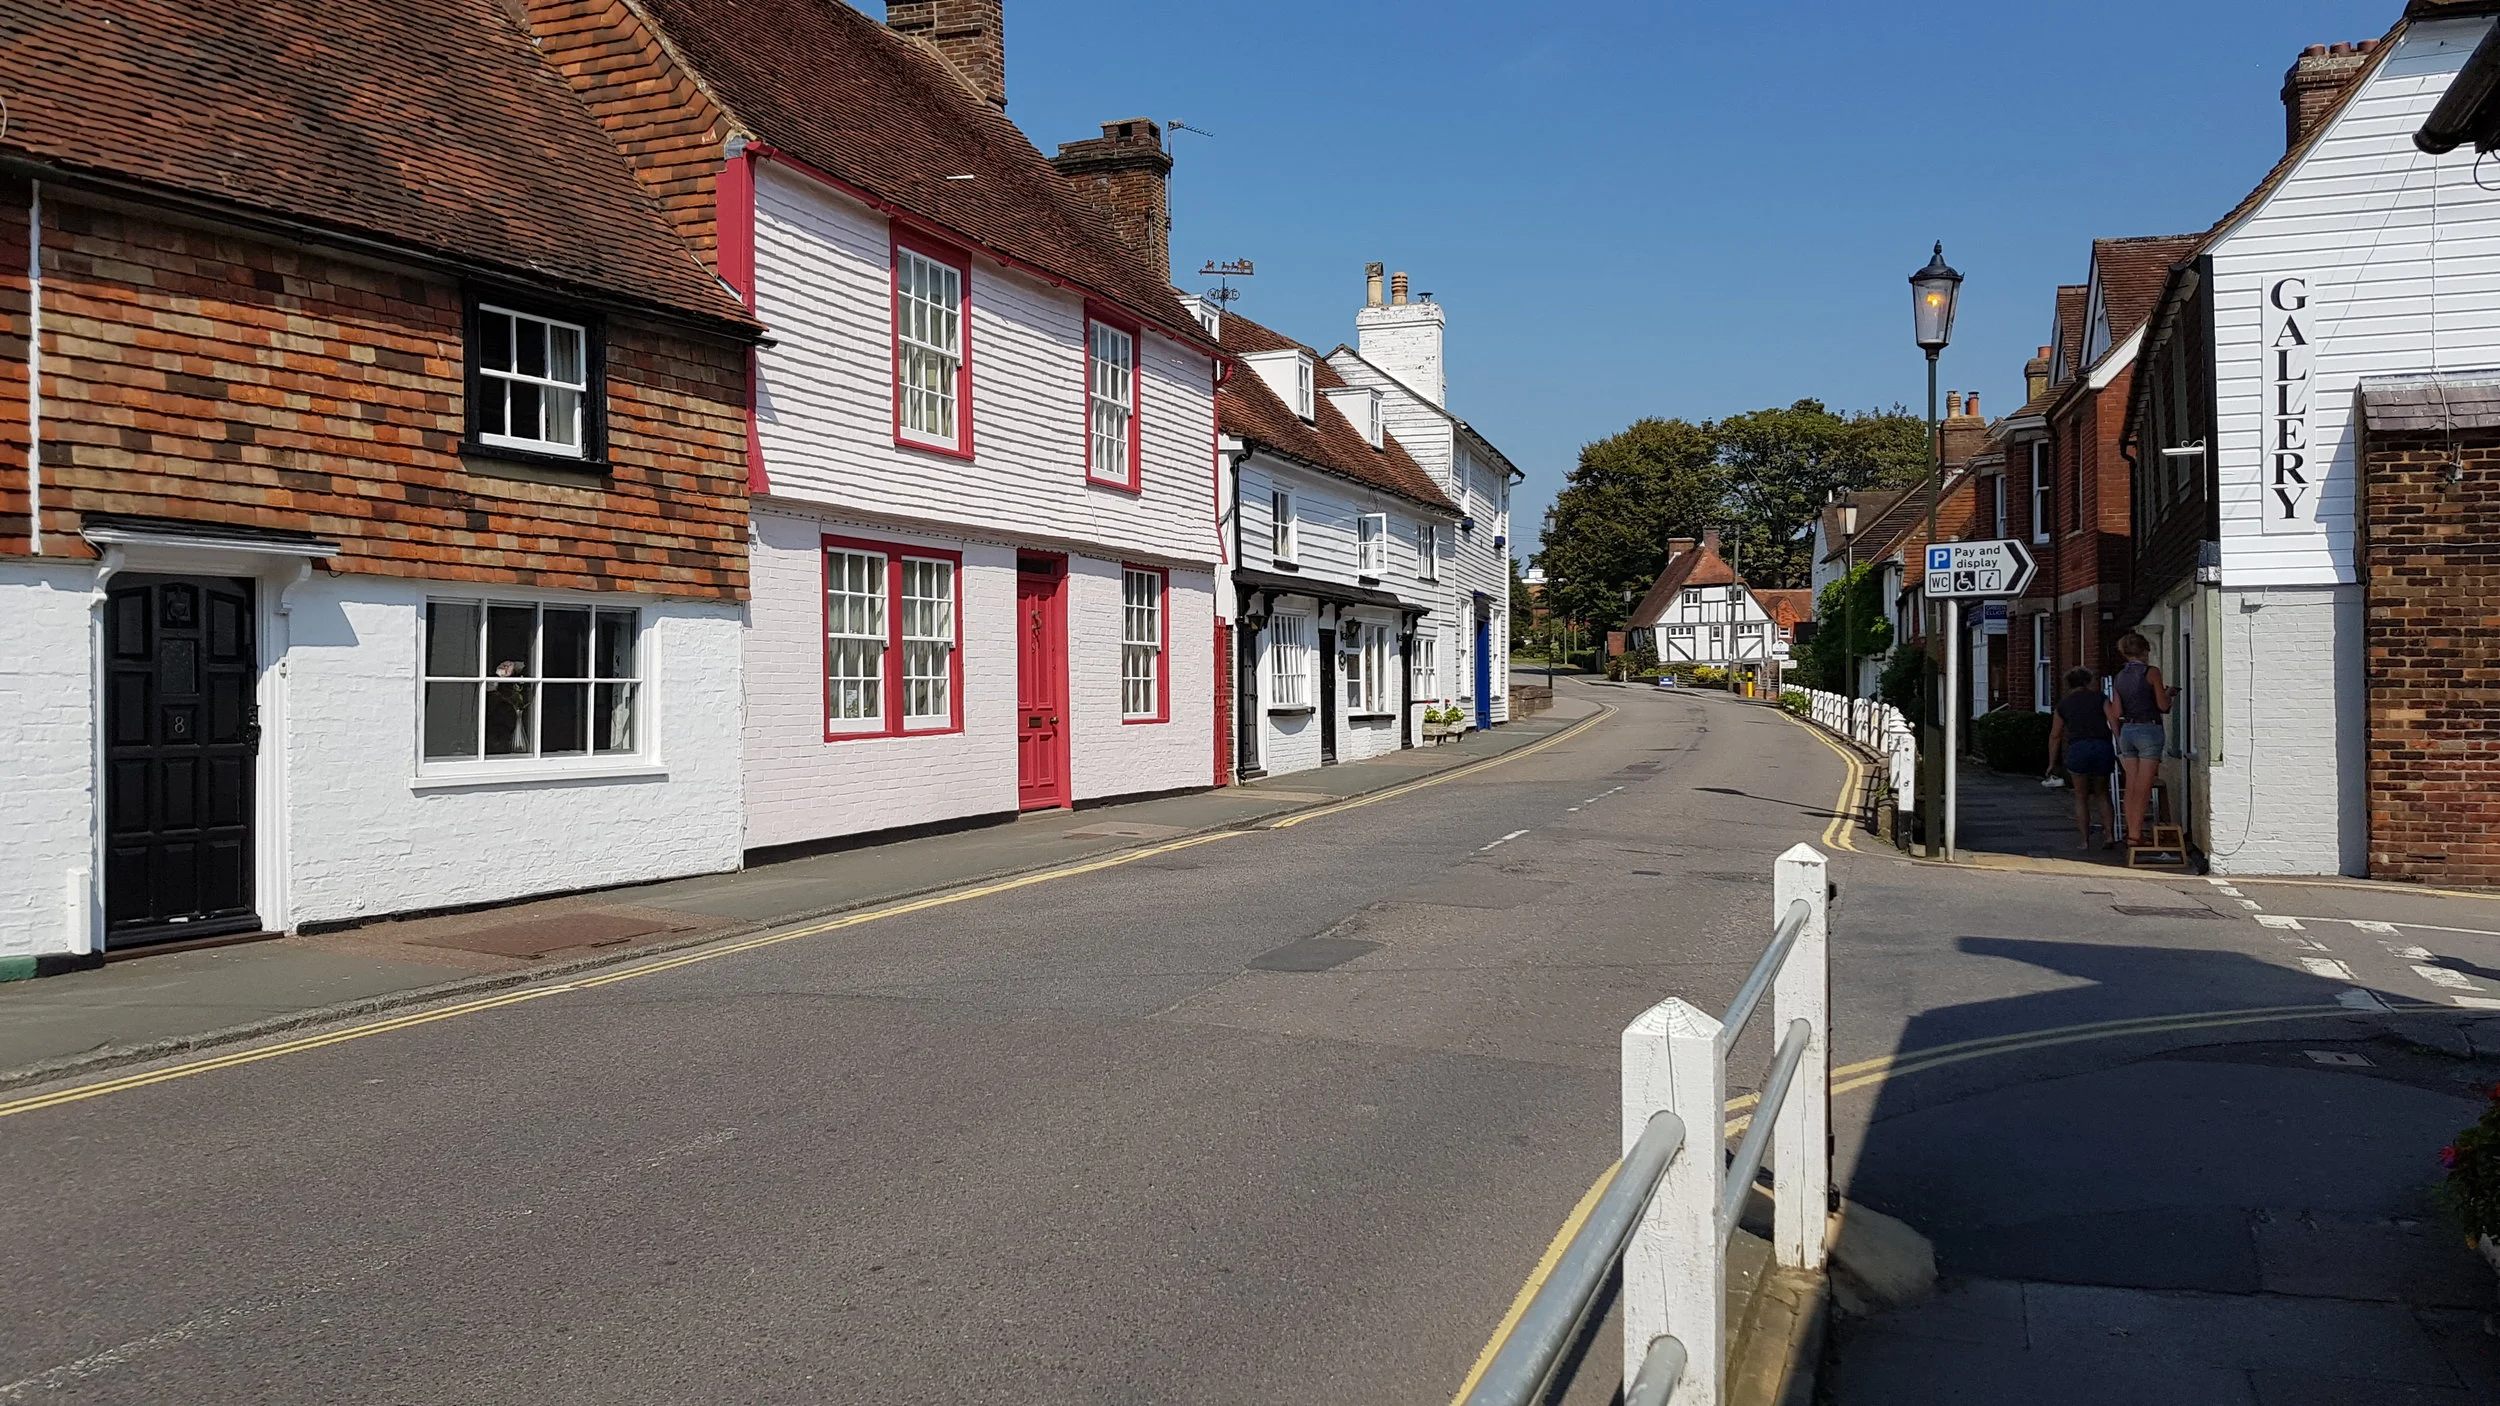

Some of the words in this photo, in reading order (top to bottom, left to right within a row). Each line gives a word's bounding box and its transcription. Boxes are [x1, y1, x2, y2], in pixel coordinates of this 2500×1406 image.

[2270, 277, 2310, 519] GALLERY
[1954, 547, 1975, 557] Pay
[1979, 545, 2001, 555] and
[1934, 550, 1948, 568] P
[1956, 558, 1998, 569] display
[1931, 576, 1948, 588] WC
[174, 716, 185, 734] 8
